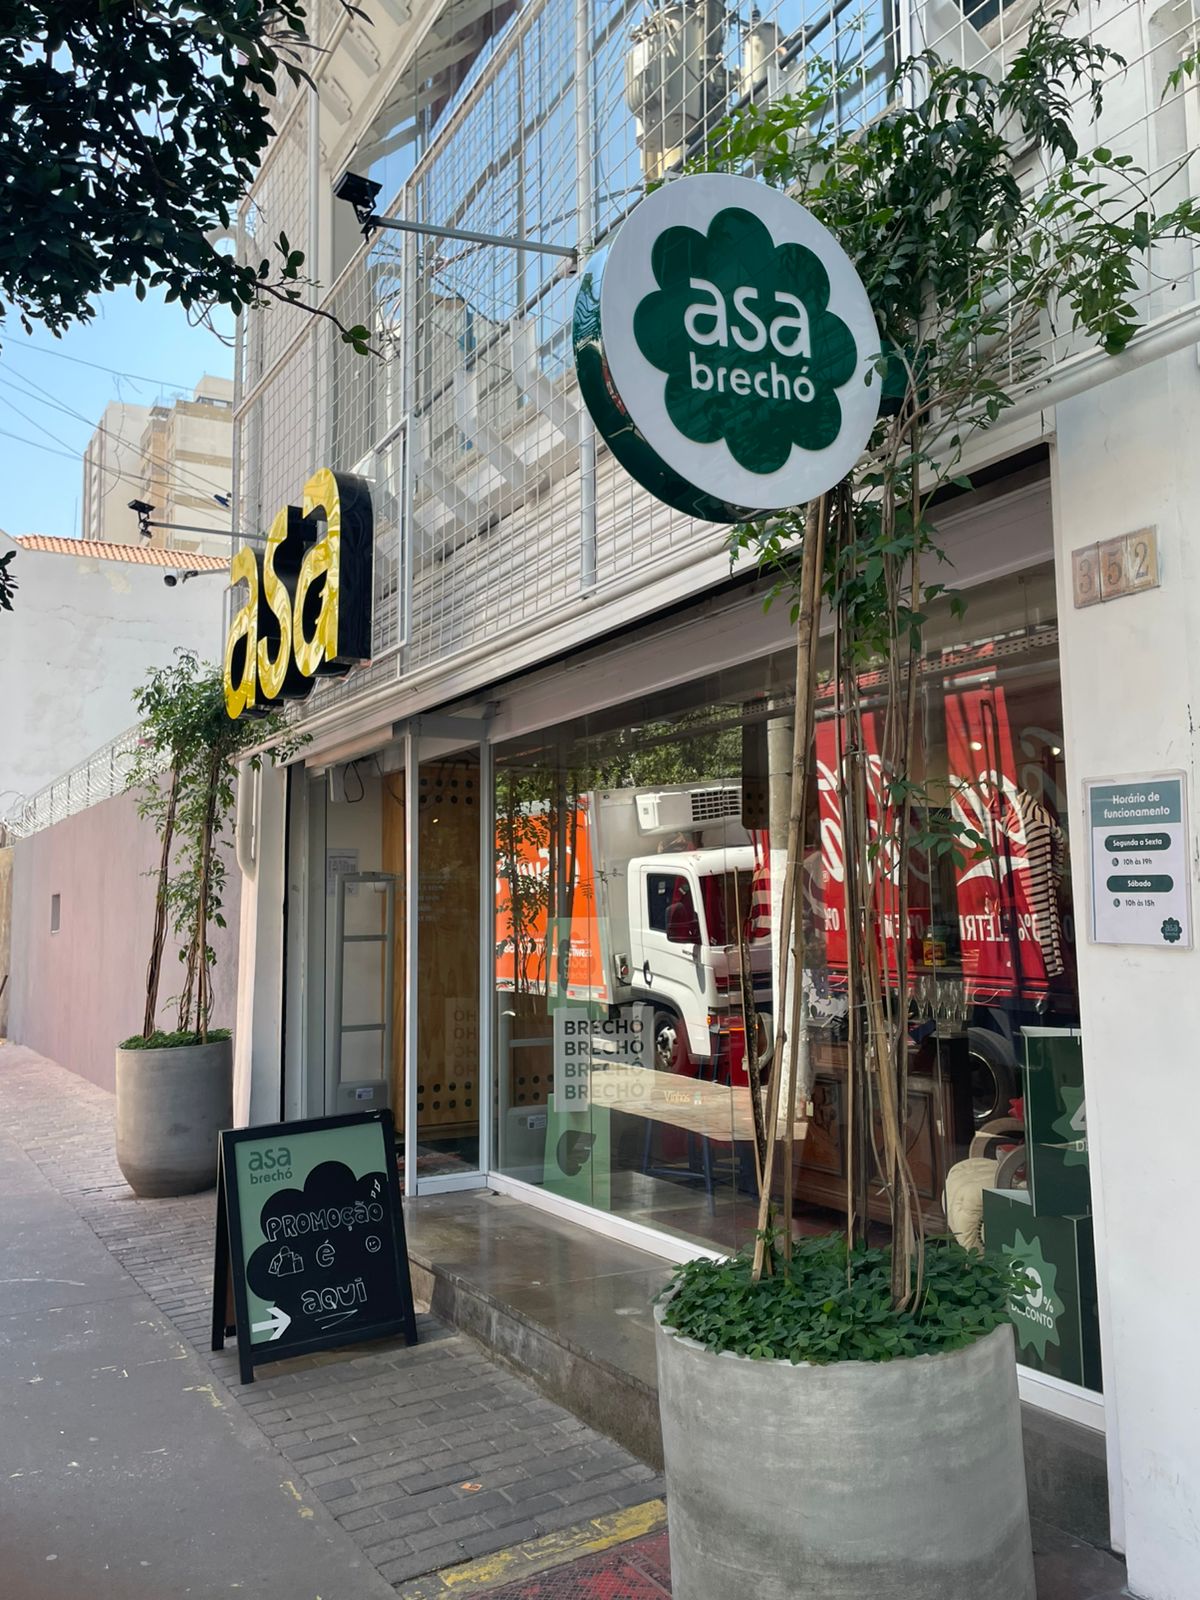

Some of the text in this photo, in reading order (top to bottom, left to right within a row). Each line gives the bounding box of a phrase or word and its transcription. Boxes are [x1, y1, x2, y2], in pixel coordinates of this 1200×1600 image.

[684, 277, 811, 358] asa
[689, 351, 815, 402] brechó
[1079, 542, 1149, 593] 352
[224, 467, 341, 719] asa
[1112, 792, 1160, 805] Horário de
[1104, 805, 1170, 819] funcionamento
[1112, 838, 1139, 848] Segunda
[1145, 838, 1162, 846] Sexta
[1123, 858, 1133, 866] 10h
[1127, 879, 1151, 888] Sábado
[1125, 899, 1136, 907] 10h
[564, 1015, 644, 1035] BRECHÓ
[565, 1036, 644, 1056] BRECHÓ
[565, 1079, 645, 1099] BRECHÓ
[249, 1147, 292, 1171] asa
[250, 1168, 293, 1185] brechó
